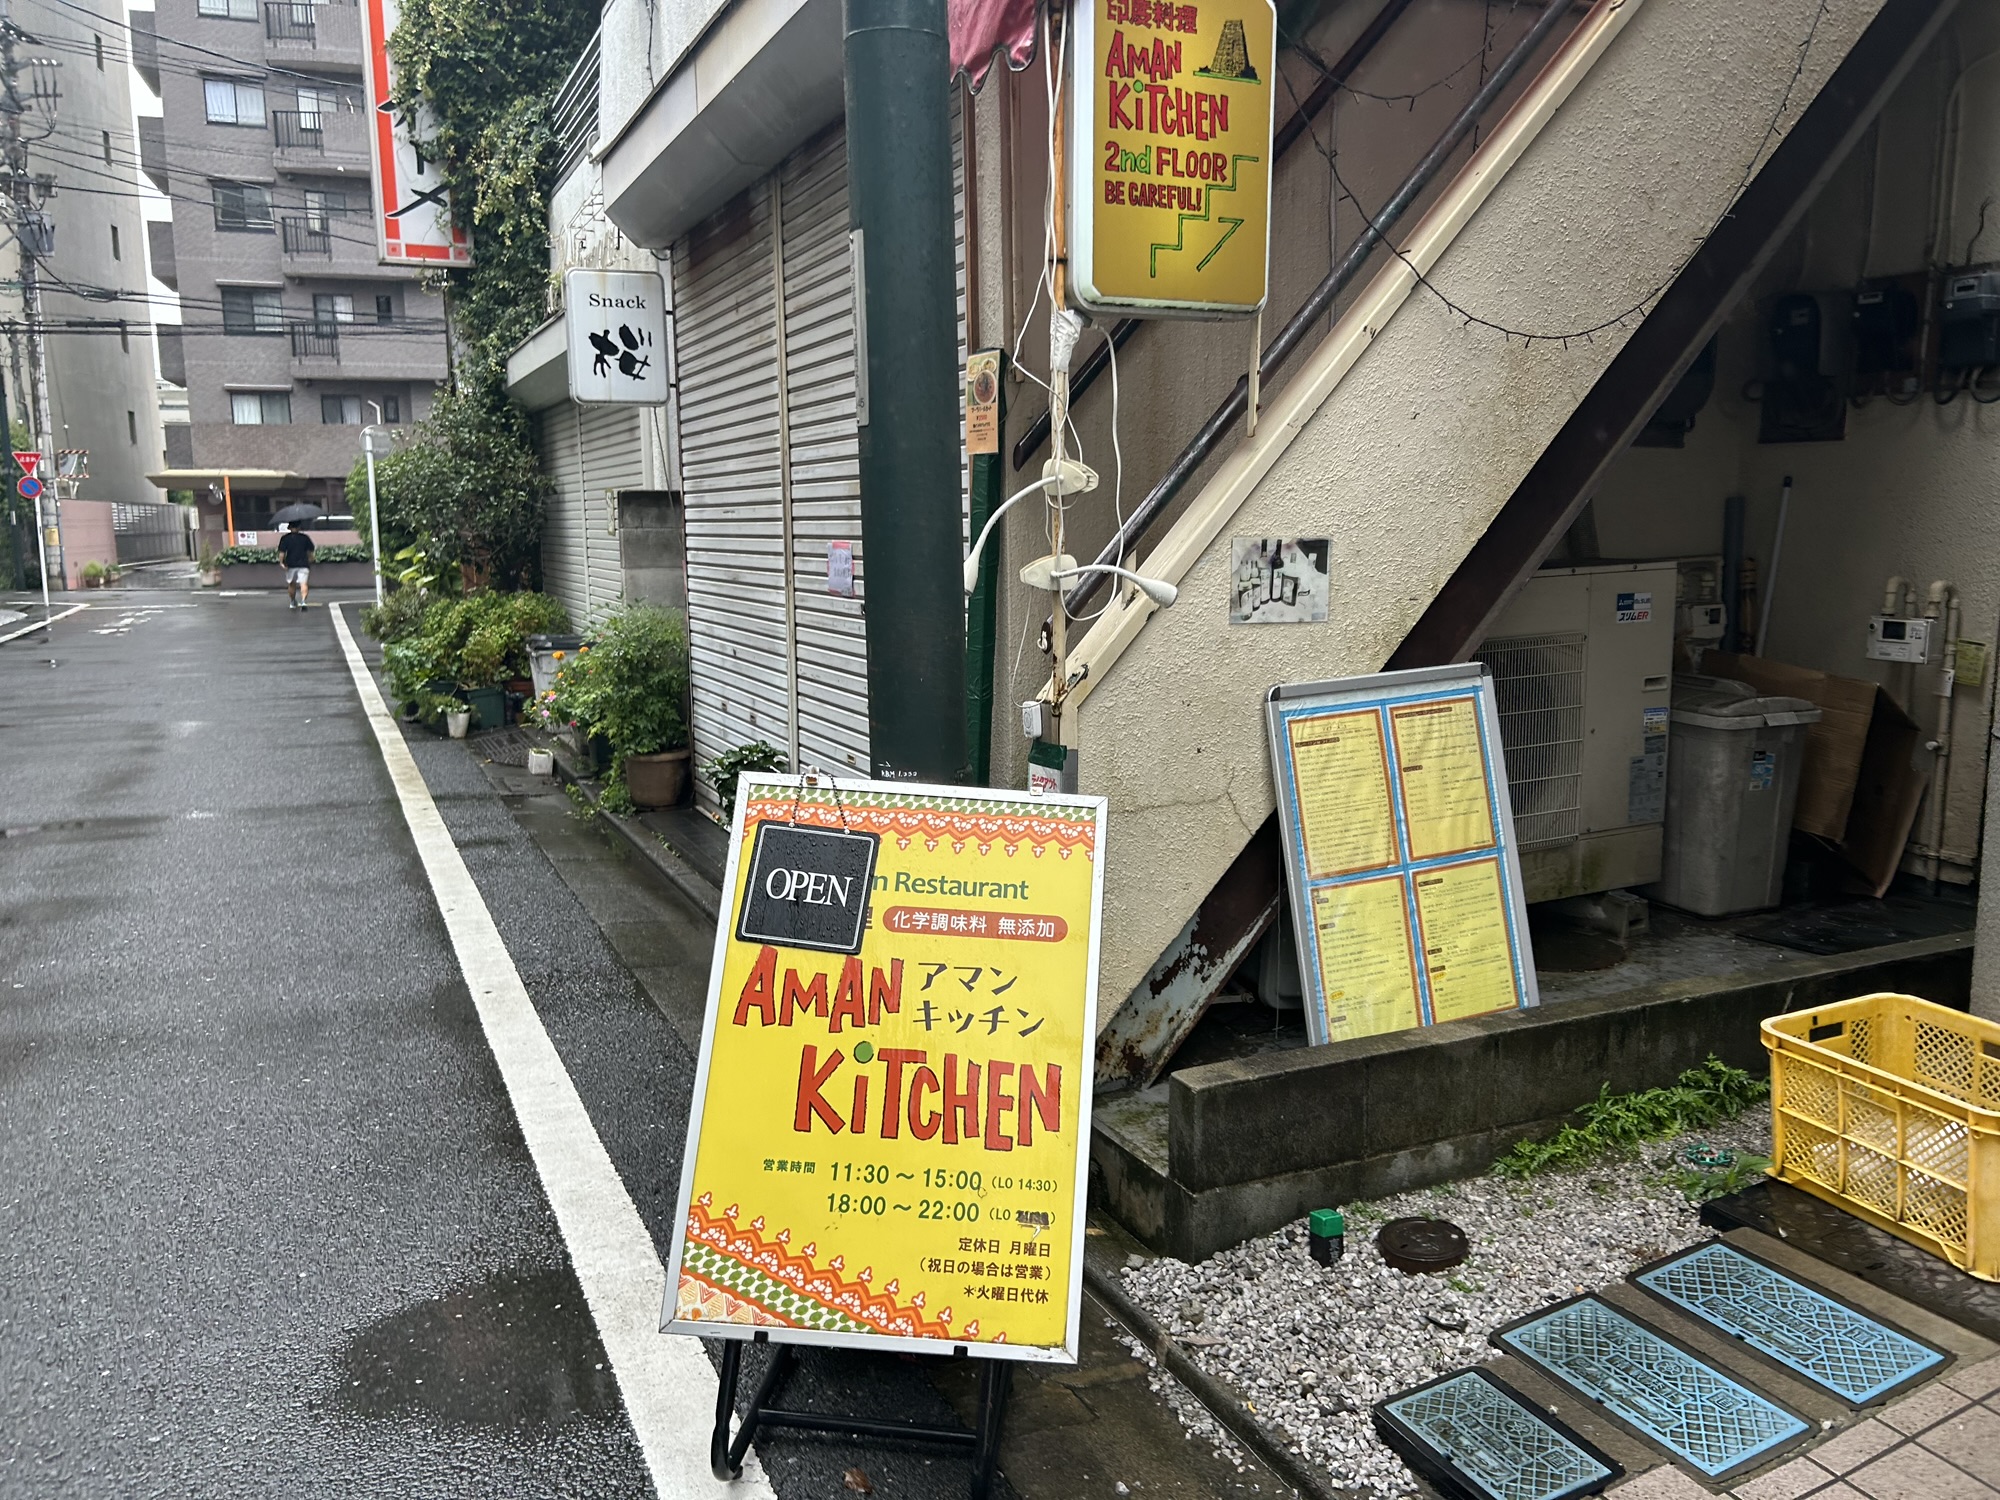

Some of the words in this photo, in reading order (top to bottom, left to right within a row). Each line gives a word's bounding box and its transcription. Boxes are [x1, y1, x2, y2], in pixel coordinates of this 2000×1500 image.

[1107, 0, 1197, 34] 印度料理
[1105, 30, 1181, 83] AMAN
[1105, 141, 1151, 174] 2nd
[1156, 147, 1227, 182] FLOOR
[1105, 180, 1125, 205] BE
[1128, 182, 1202, 211] CAREFUL!
[589, 293, 646, 309] Snack
[765, 867, 853, 908] OPEN
[893, 871, 1029, 900] Restaurant
[892, 910, 987, 934] 化学調味料
[997, 917, 1055, 938] 無添加
[732, 944, 904, 1034] AMAN
[917, 962, 1018, 995] アマン
[913, 1000, 1045, 1037] キッチン
[763, 1158, 816, 1174] 営業時間
[958, 1238, 1000, 1254] 定休日
[1008, 1241, 1051, 1257] 月曜日
